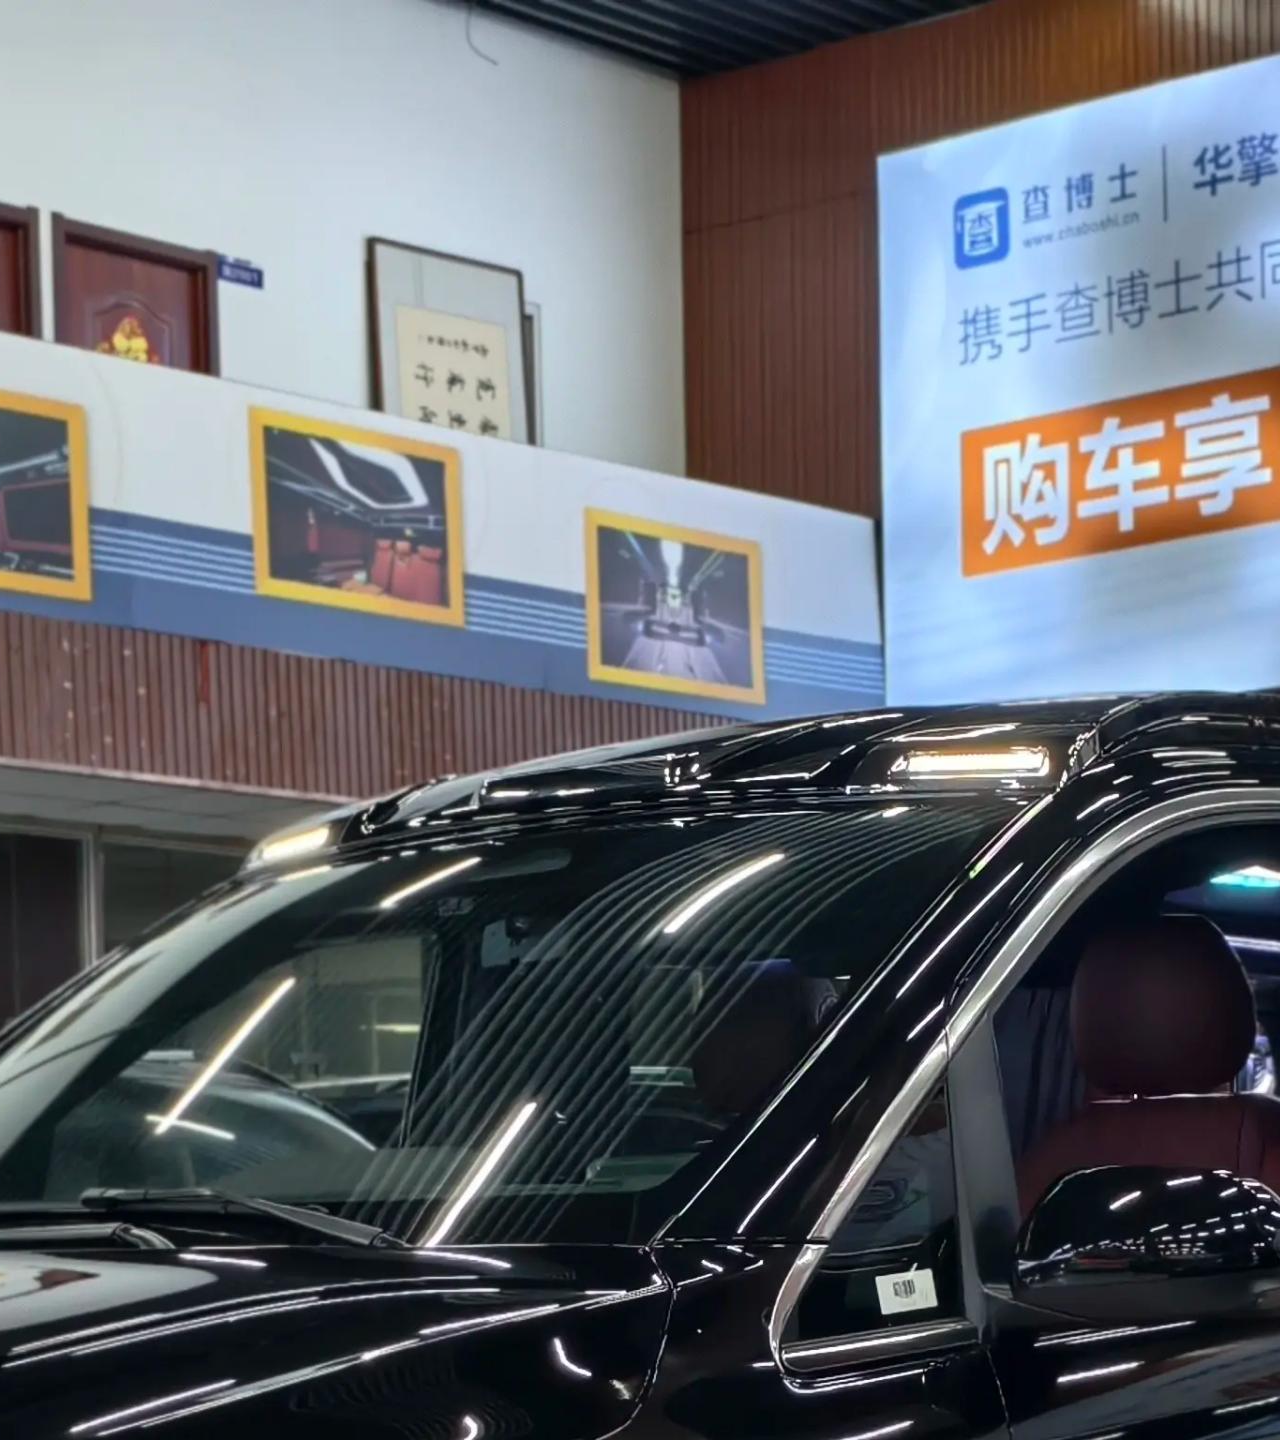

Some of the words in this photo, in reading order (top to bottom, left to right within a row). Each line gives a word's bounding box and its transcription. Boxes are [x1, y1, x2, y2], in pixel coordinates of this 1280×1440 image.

[1022, 162, 1138, 225] 查博士
[981, 393, 1274, 556] 购车享
